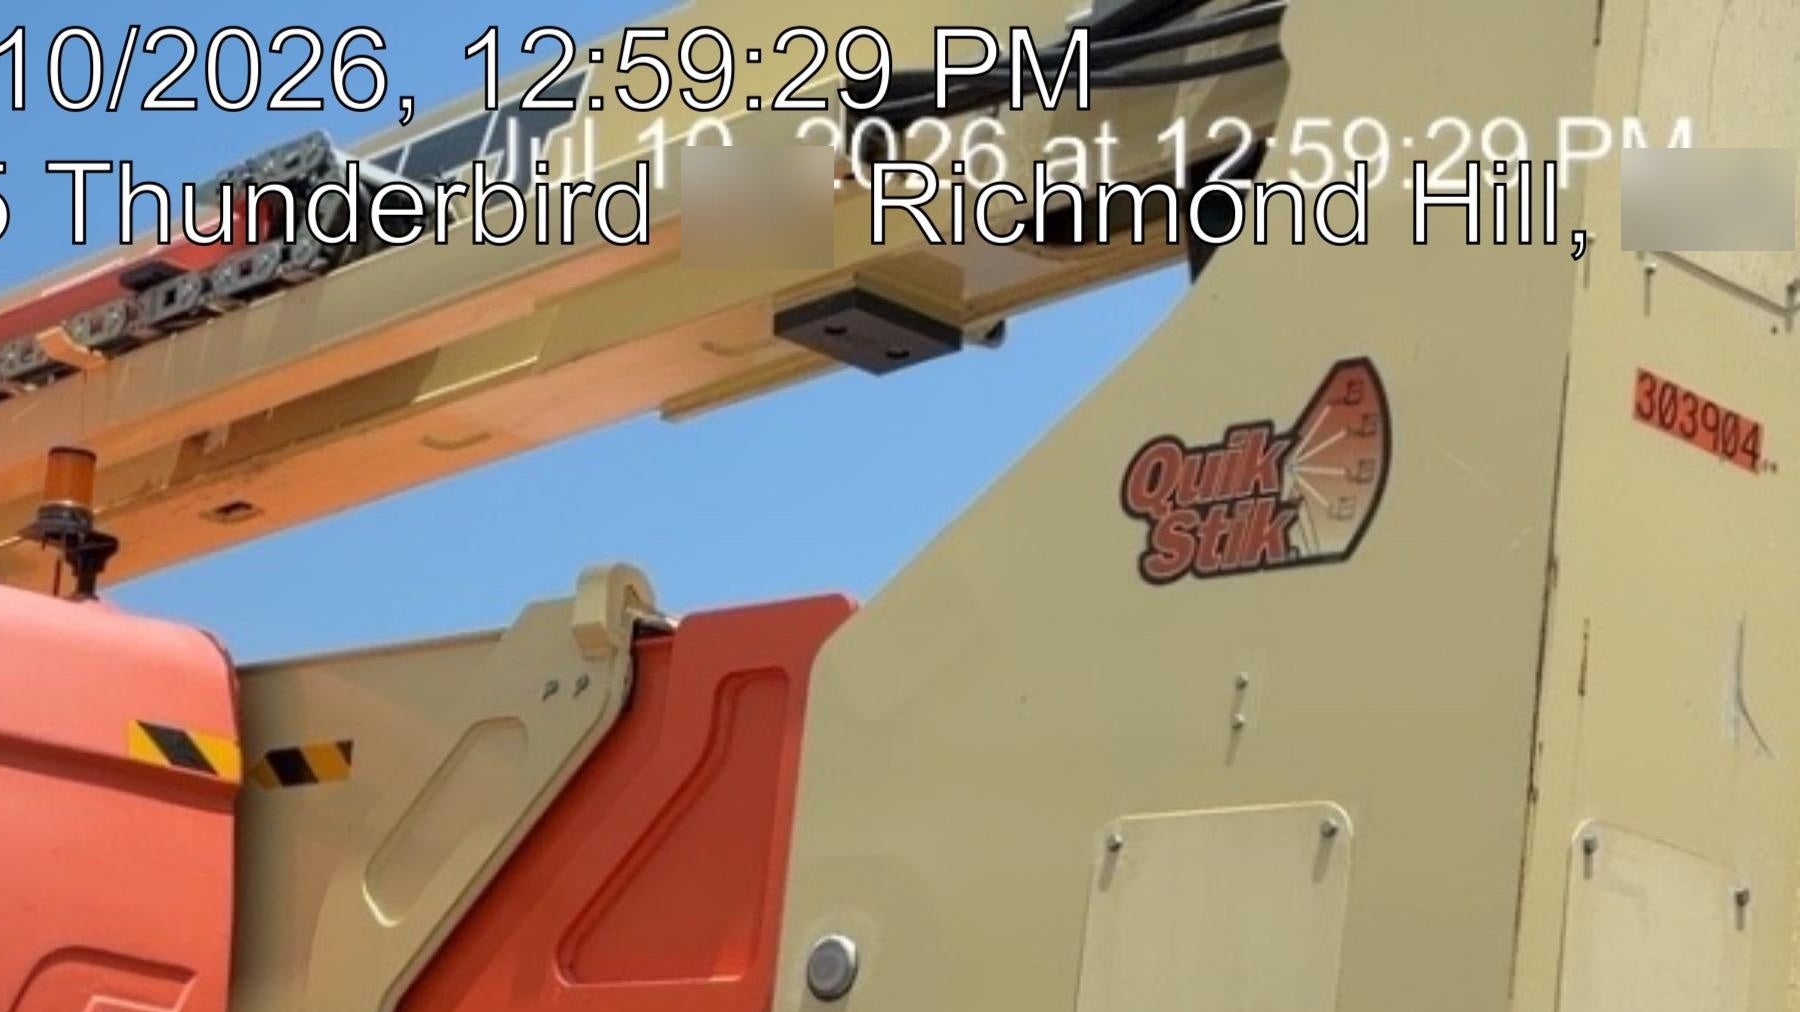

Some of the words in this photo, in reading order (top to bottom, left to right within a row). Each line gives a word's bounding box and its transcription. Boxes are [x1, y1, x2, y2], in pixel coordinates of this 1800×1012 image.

[1635, 371, 1761, 474] 303904
[1126, 423, 1291, 519] Quik
[1141, 497, 1299, 579] Stik
